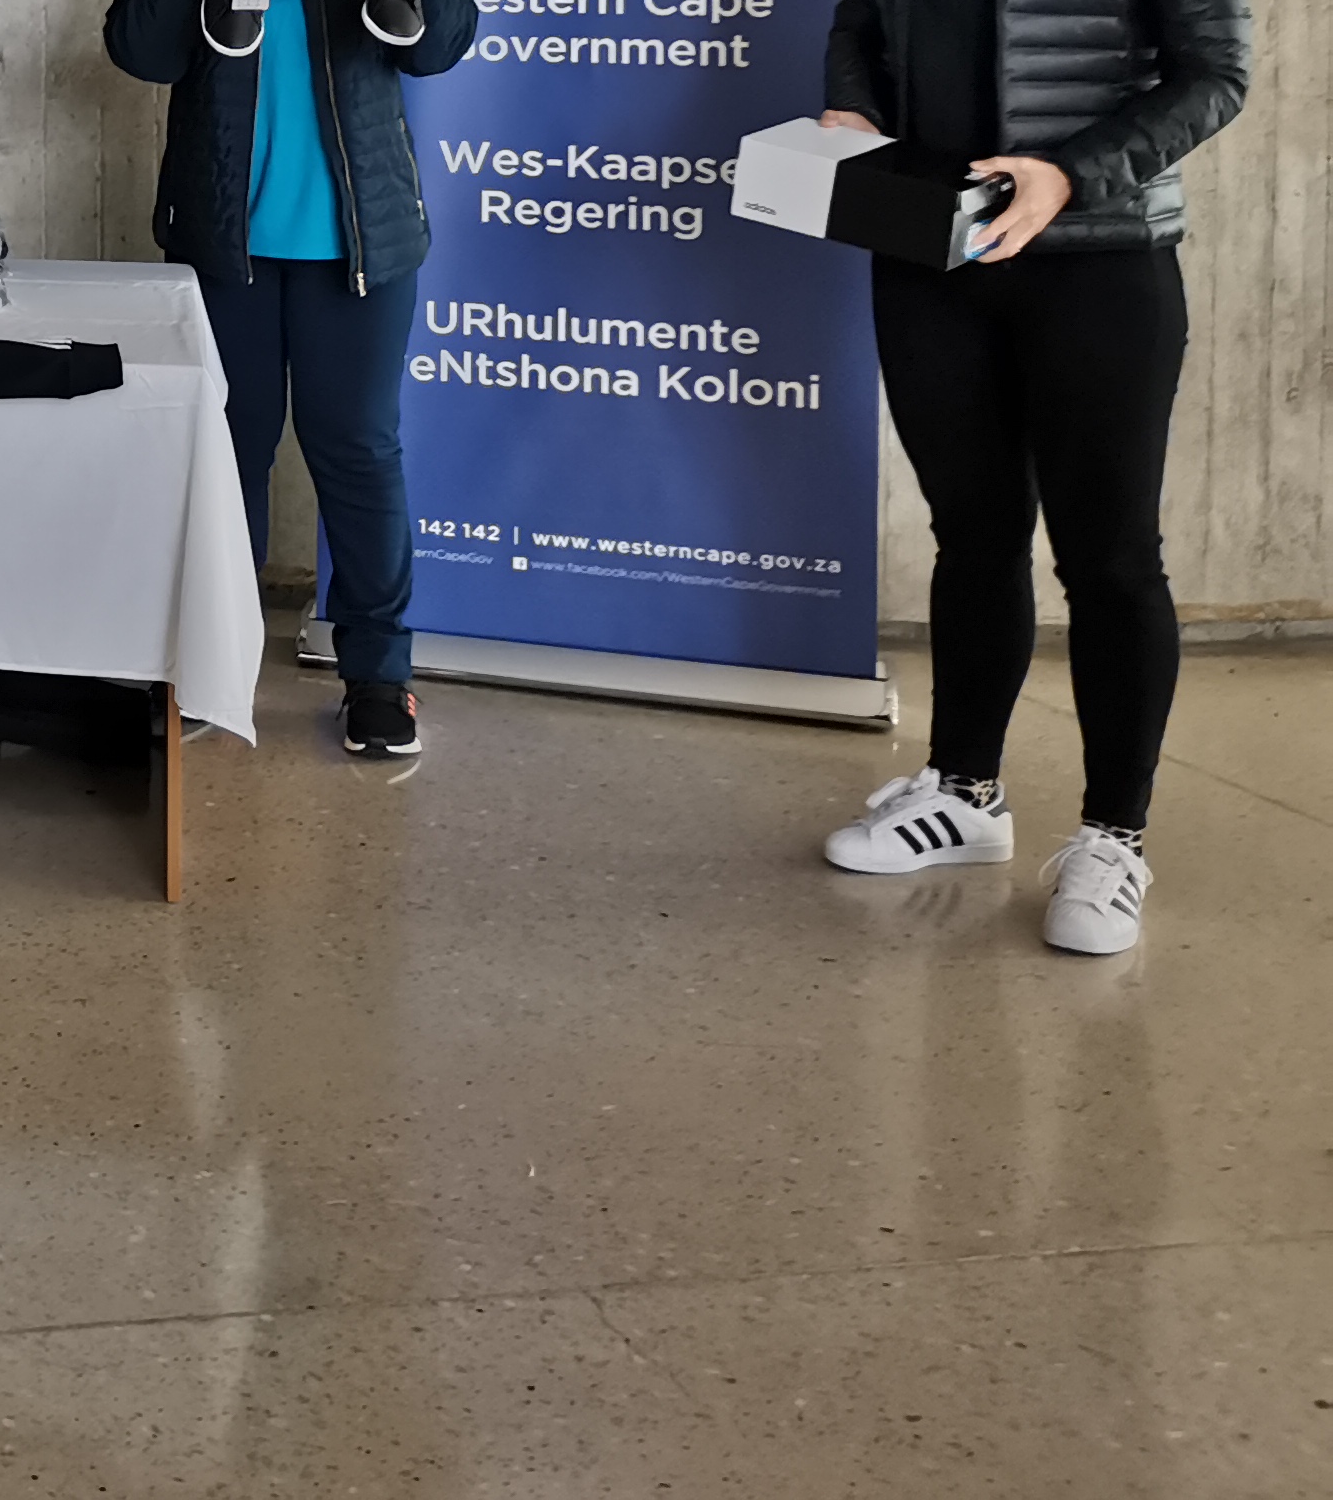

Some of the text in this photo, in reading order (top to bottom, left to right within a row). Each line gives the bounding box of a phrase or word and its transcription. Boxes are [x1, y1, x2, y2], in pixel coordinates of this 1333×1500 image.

[463, 28, 749, 68] overnment
[439, 138, 736, 189] Wes-Kaapse
[479, 189, 702, 239] Regering
[425, 299, 761, 355] URhulumente
[409, 349, 819, 409] eNtshona Koloni
[418, 519, 841, 573] 142 142 www.westerncape.gov.za
